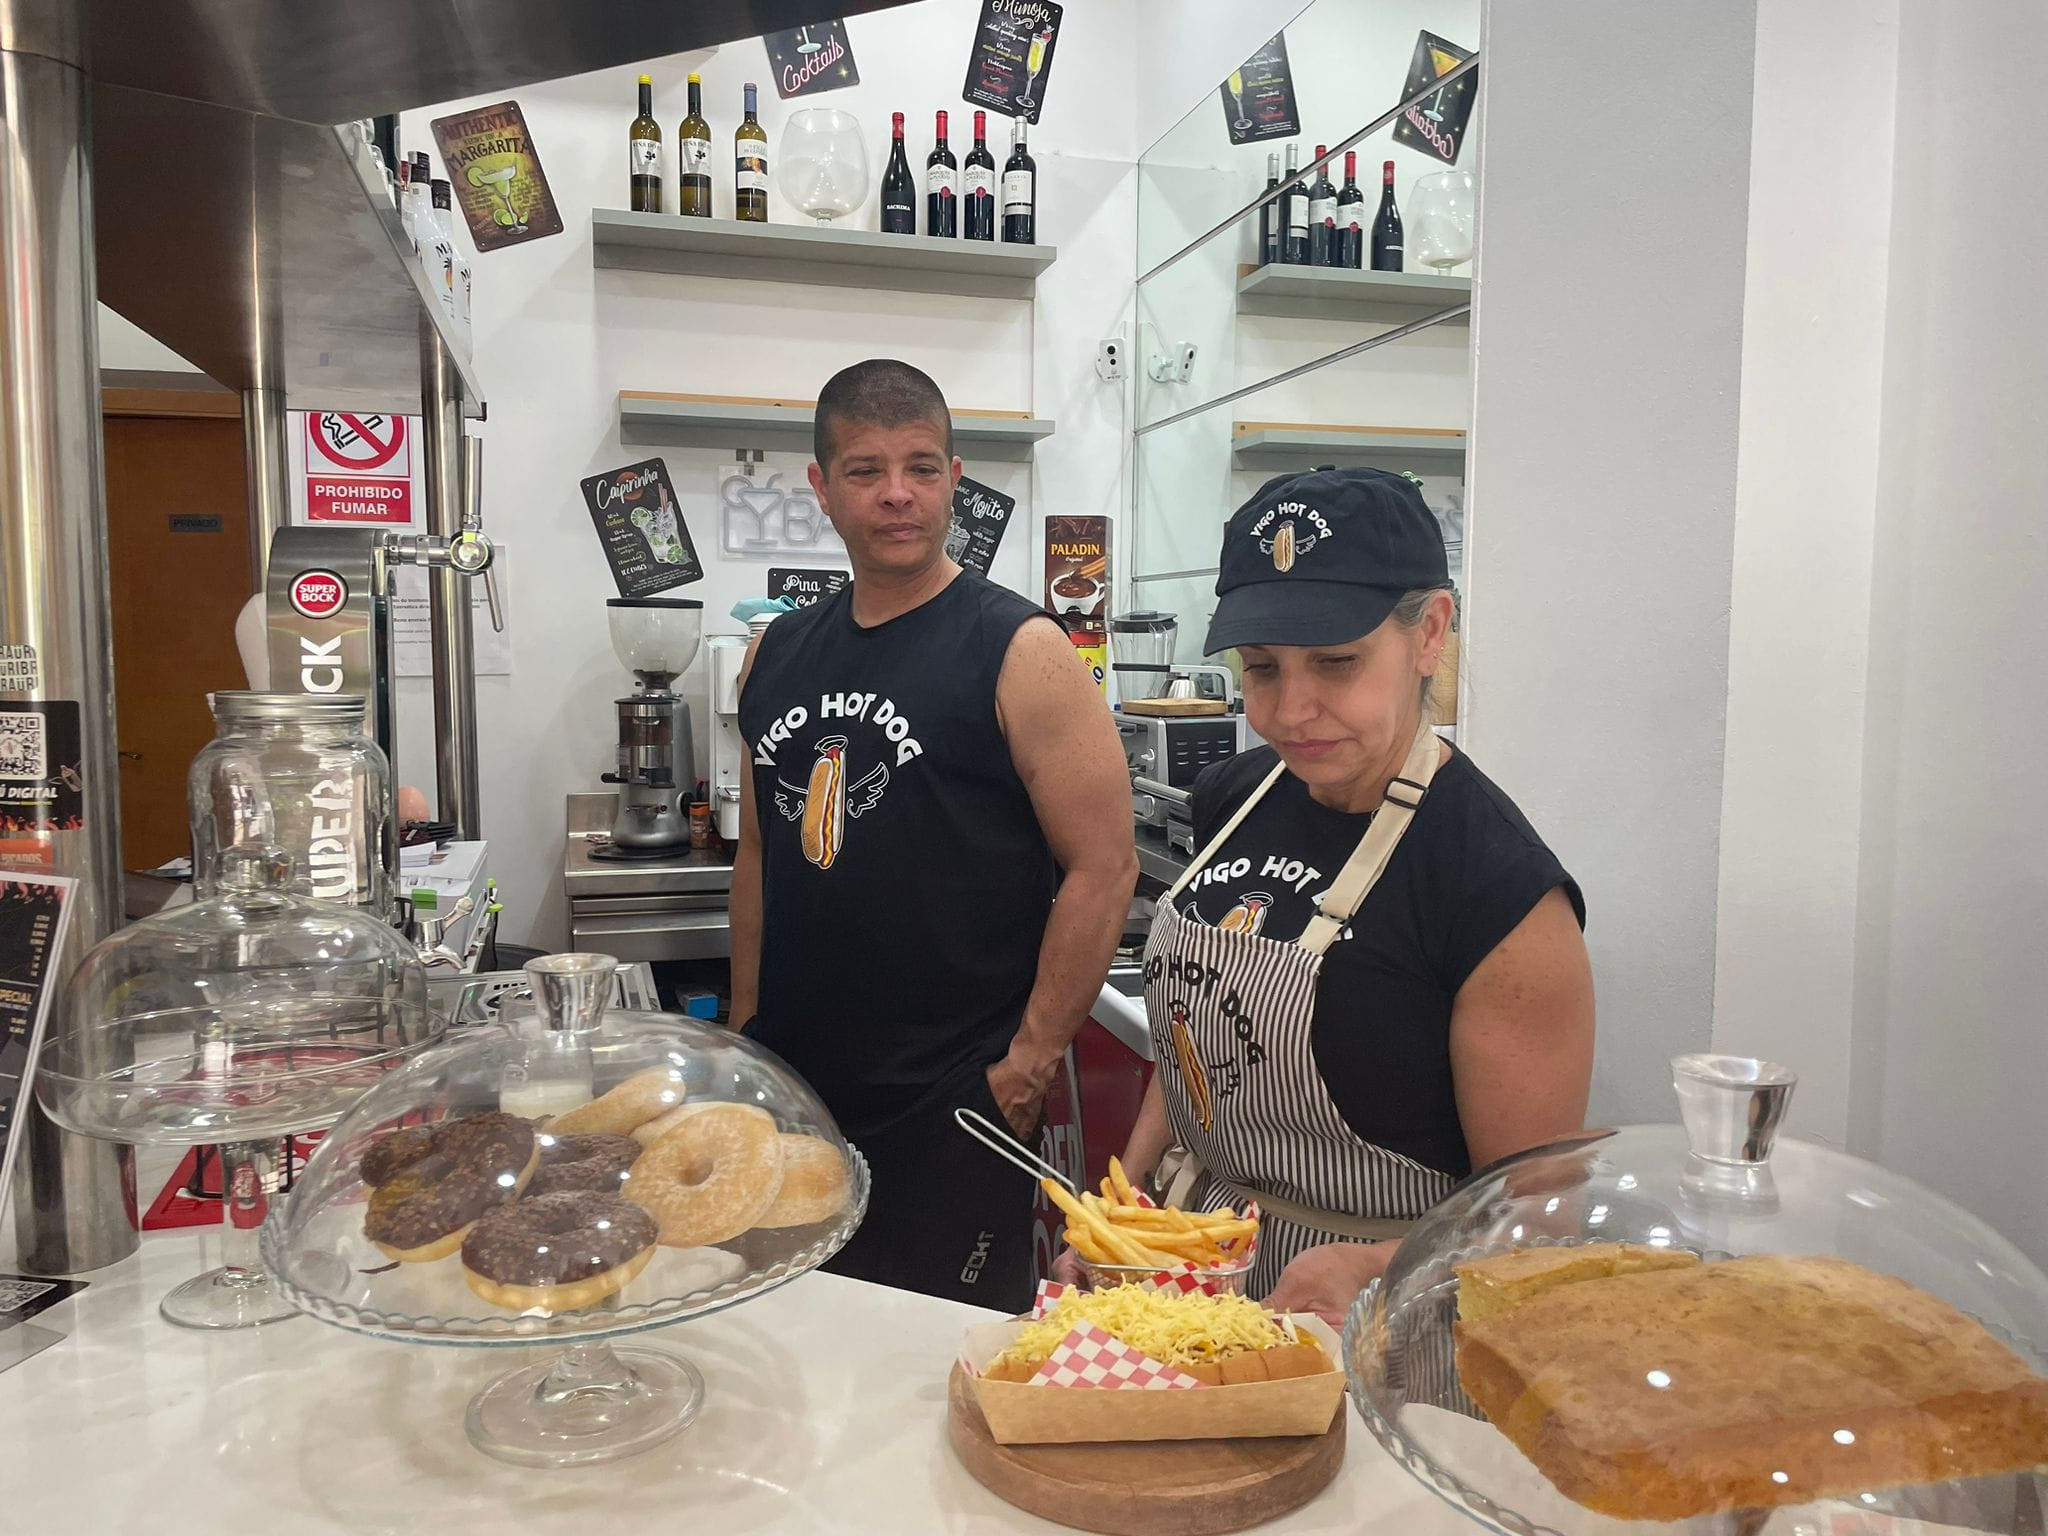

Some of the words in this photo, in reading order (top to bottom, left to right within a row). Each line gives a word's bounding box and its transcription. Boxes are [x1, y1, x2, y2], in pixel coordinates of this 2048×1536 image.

[783, 33, 845, 93] Cocktails
[441, 112, 520, 142] AUTHENTIC
[448, 137, 533, 172] MARGARITA
[315, 485, 403, 499] PROHIBIDO
[596, 468, 659, 510] Caipirinha
[332, 502, 388, 515] FUMAR
[963, 492, 1005, 520] Mojito
[1250, 510, 1275, 537] VIGO
[1278, 502, 1307, 517] HOT
[1307, 509, 1333, 539] DOG
[1051, 544, 1100, 555] PALADIN
[299, 584, 336, 594] SUPER
[301, 593, 335, 602] BOCK
[301, 635, 344, 696] CK
[754, 706, 808, 766] VIGO
[821, 692, 877, 723] HOT
[872, 698, 923, 767] DOG
[8, 786, 58, 798] DIGITAL
[1188, 858, 1251, 893] VIGO
[1259, 855, 1322, 894] HOT
[1168, 953, 1222, 999] HOT
[1221, 988, 1268, 1066] DOG
